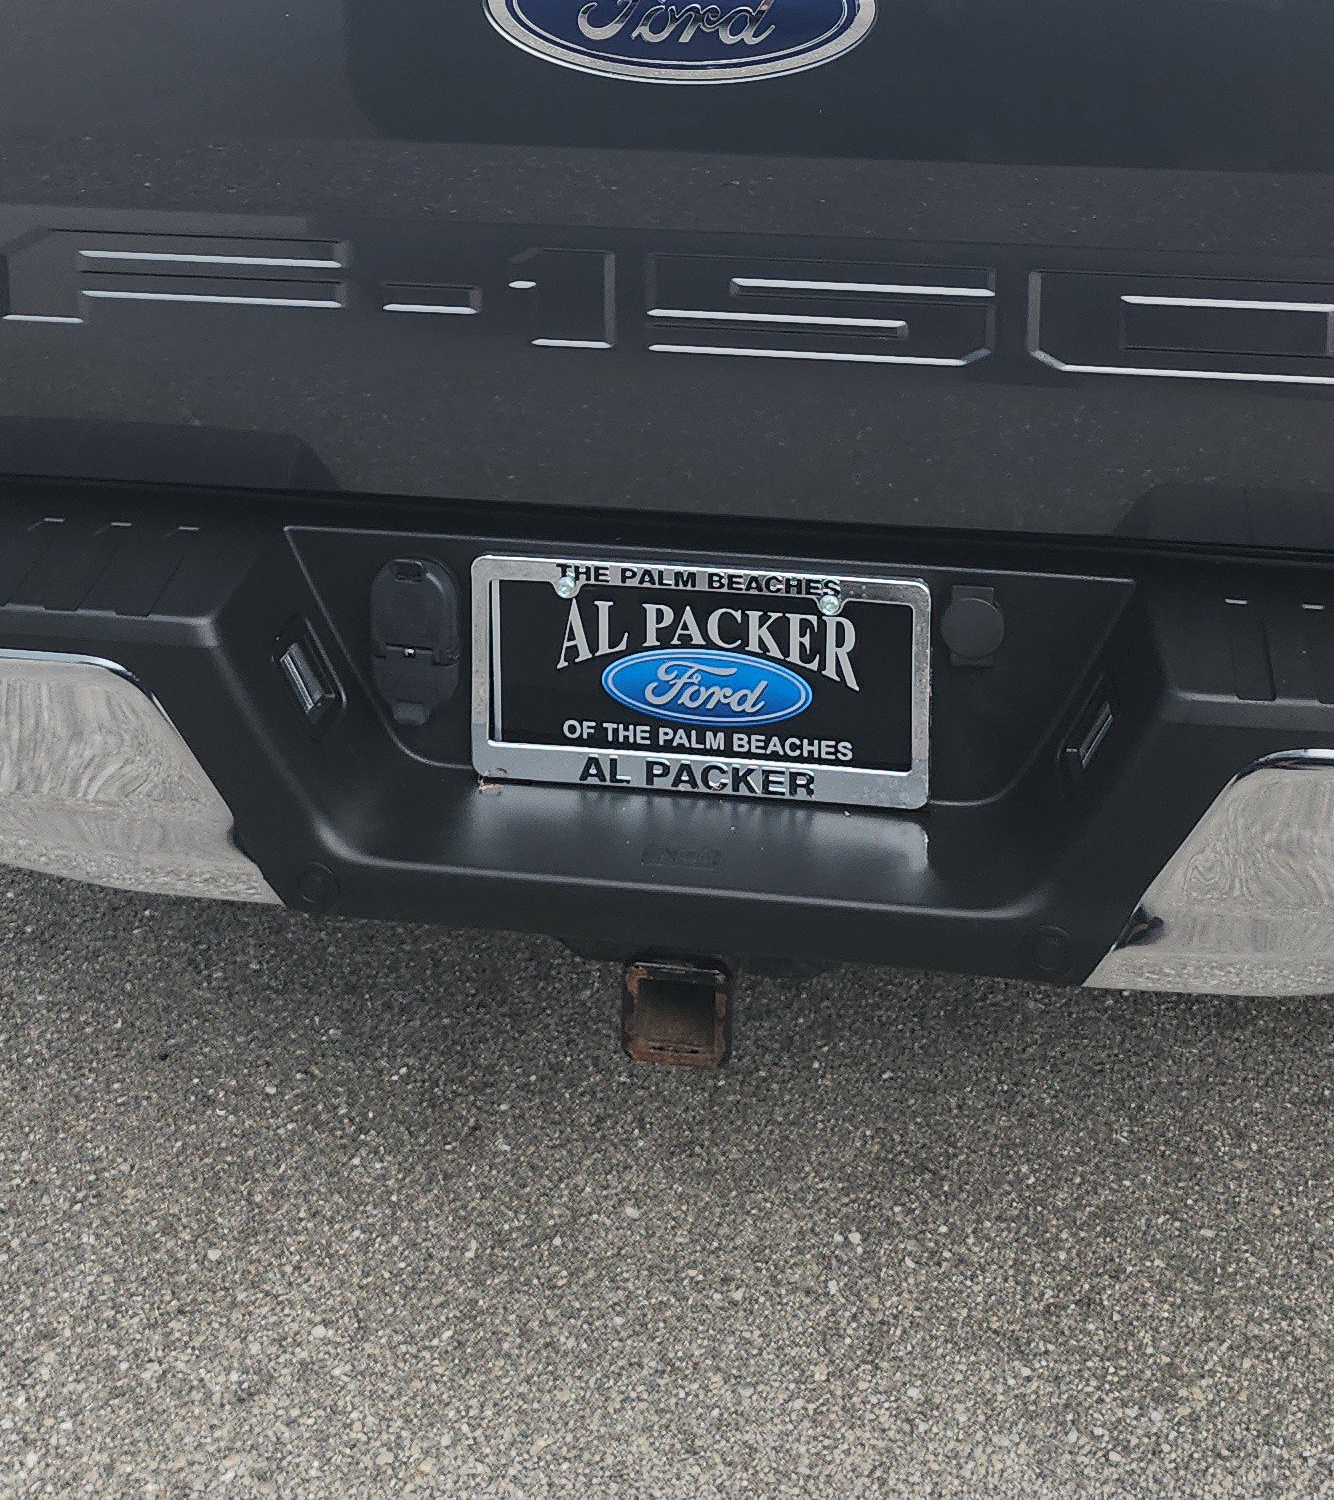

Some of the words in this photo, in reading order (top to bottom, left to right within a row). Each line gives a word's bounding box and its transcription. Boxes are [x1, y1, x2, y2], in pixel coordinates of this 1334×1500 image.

[556, 563, 609, 583] THE
[620, 567, 697, 588] PALM
[707, 572, 842, 596] BEACHES
[557, 598, 629, 669] AL
[641, 603, 860, 692] PACKER
[644, 660, 769, 714] Ford
[563, 719, 596, 739] OF
[602, 723, 651, 744] THE
[658, 727, 725, 751] PALM
[732, 733, 853, 761] BEACHES
[579, 753, 632, 784] AL
[645, 757, 816, 798] PACKER
